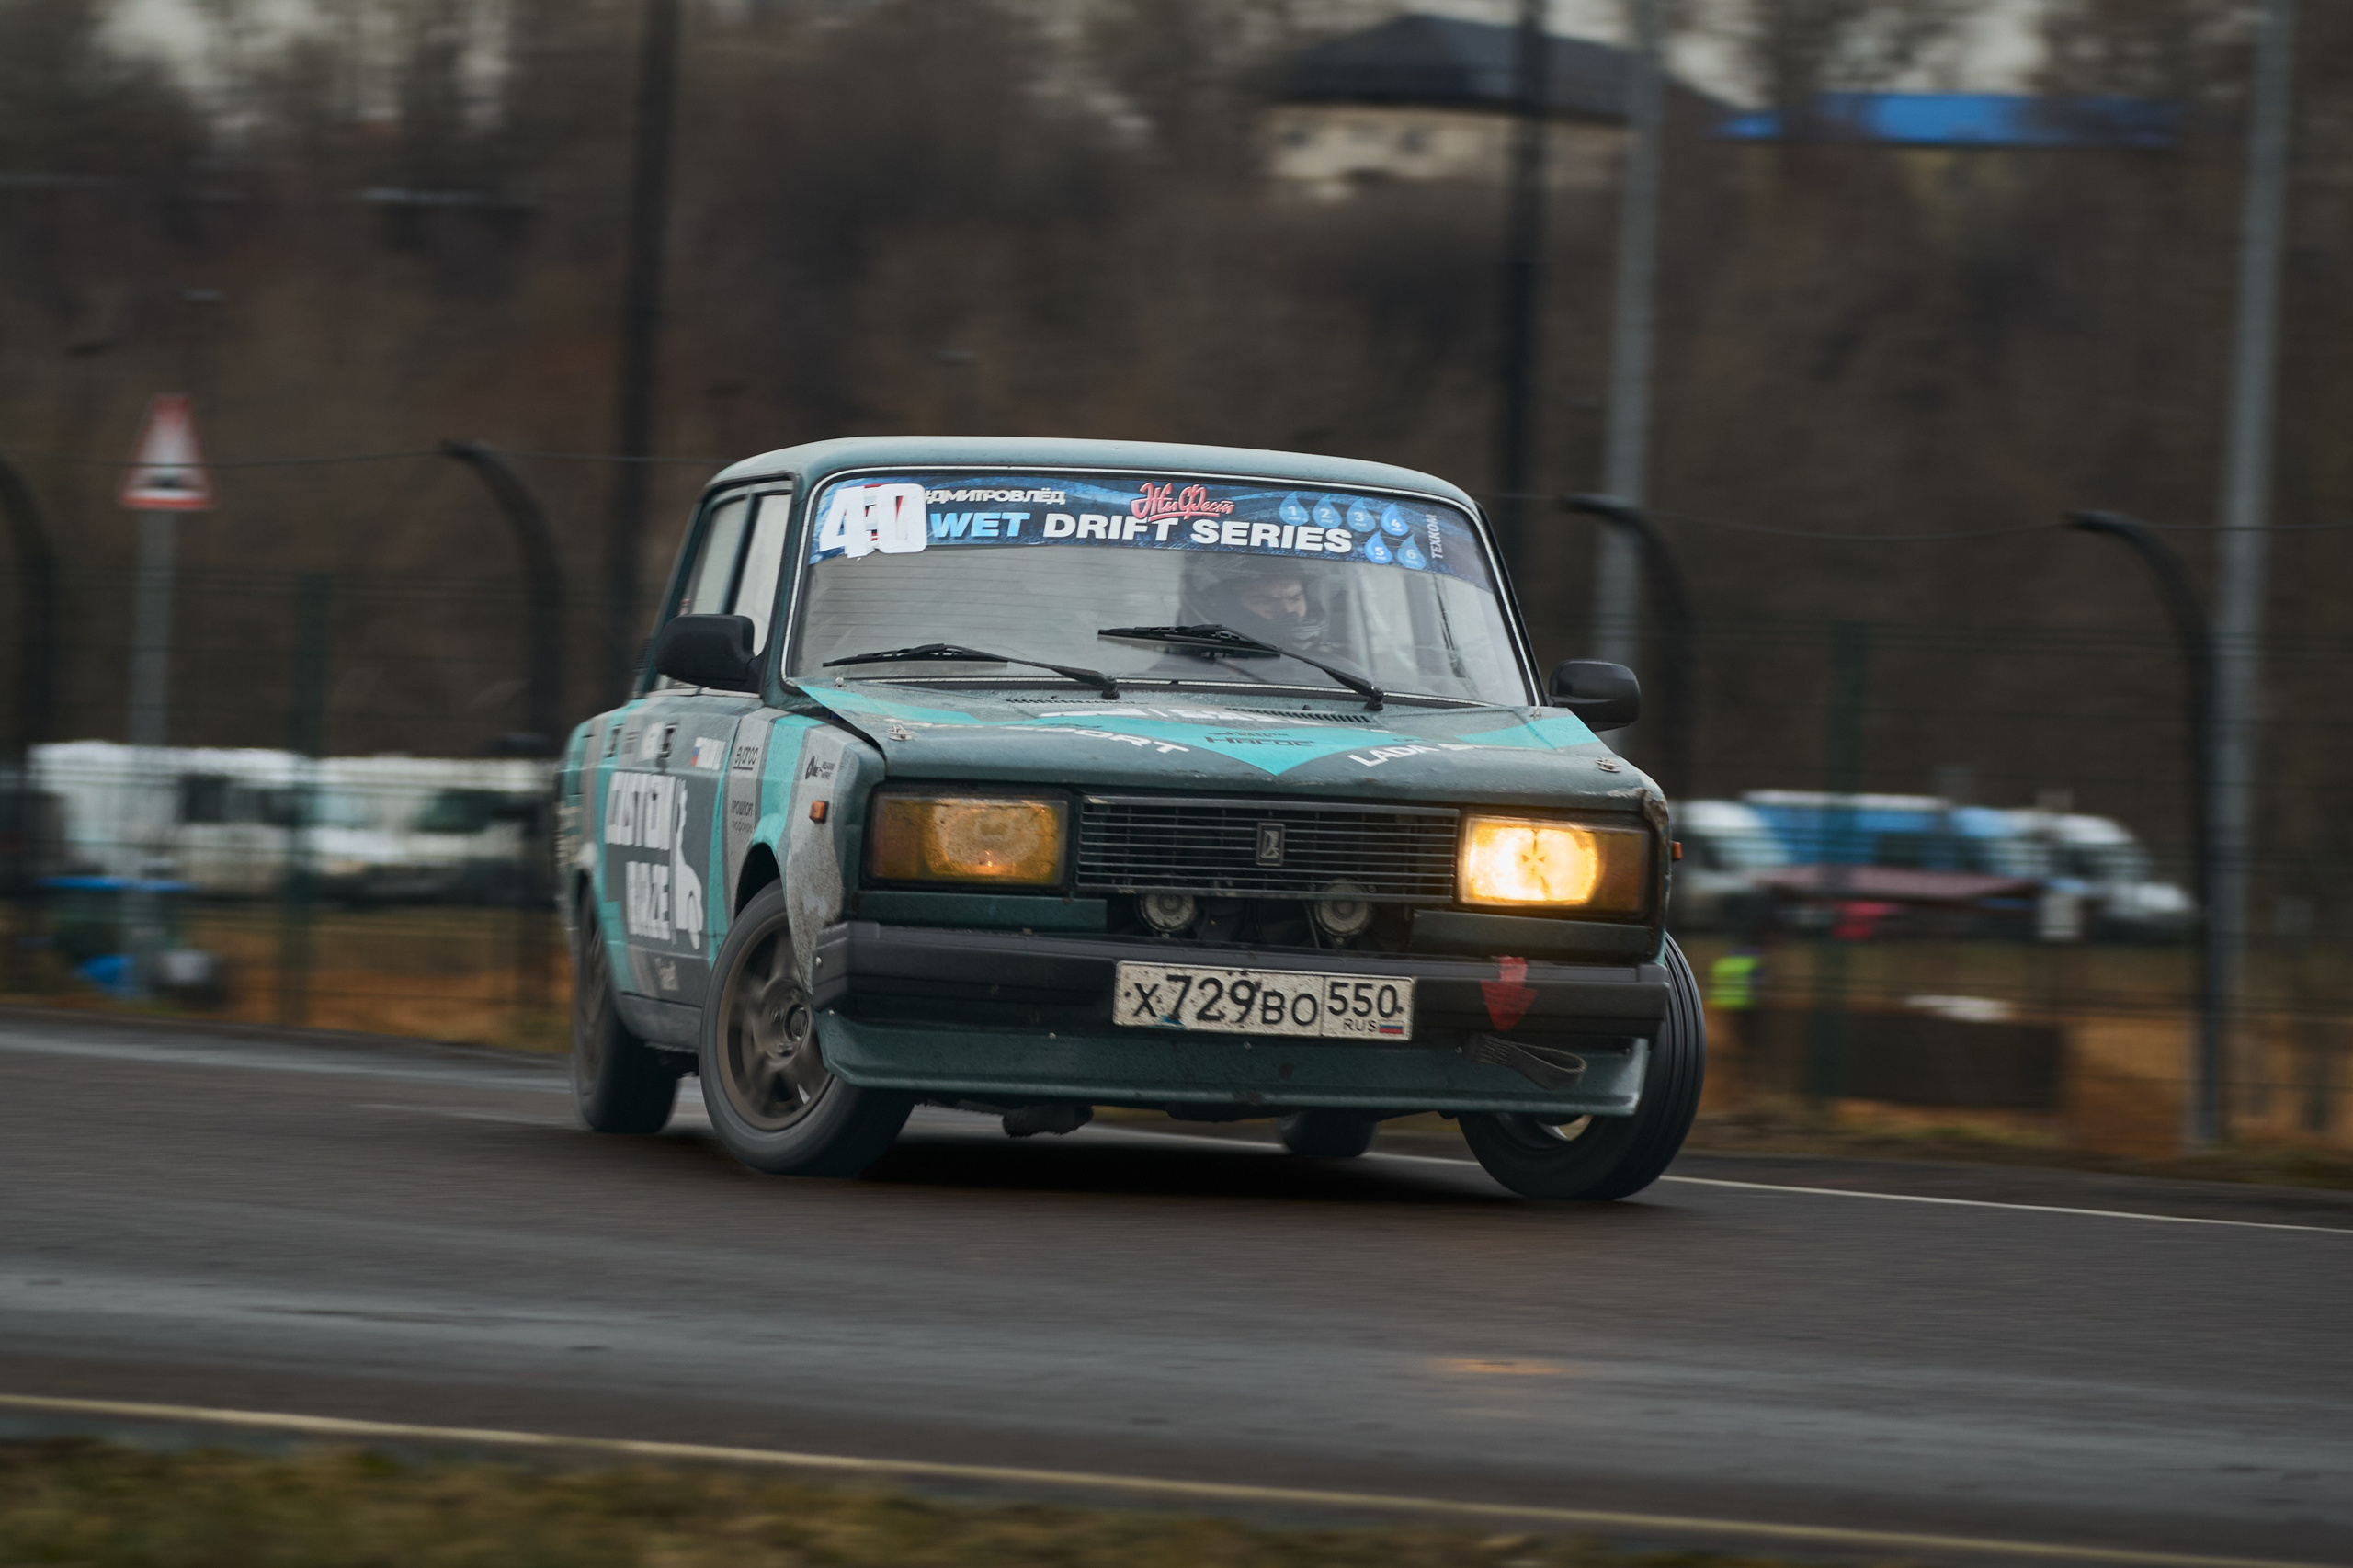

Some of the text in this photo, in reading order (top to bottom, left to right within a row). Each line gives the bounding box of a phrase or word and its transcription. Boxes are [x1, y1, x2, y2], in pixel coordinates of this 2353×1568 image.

[1287, 506, 1297, 516] 1
[1320, 507, 1331, 518] 2
[1353, 511, 1364, 522] 3
[1391, 518, 1402, 528] 4
[930, 512, 1353, 553] WET DRIFT SERIES
[1426, 514, 1443, 559] ТЕХКОМ
[1374, 546, 1385, 556] 5
[1405, 549, 1416, 560] 6
[1347, 745, 1440, 767] LADA
[1132, 975, 1398, 1027] Х729ВО 550
[1343, 1018, 1377, 1033] RUS
